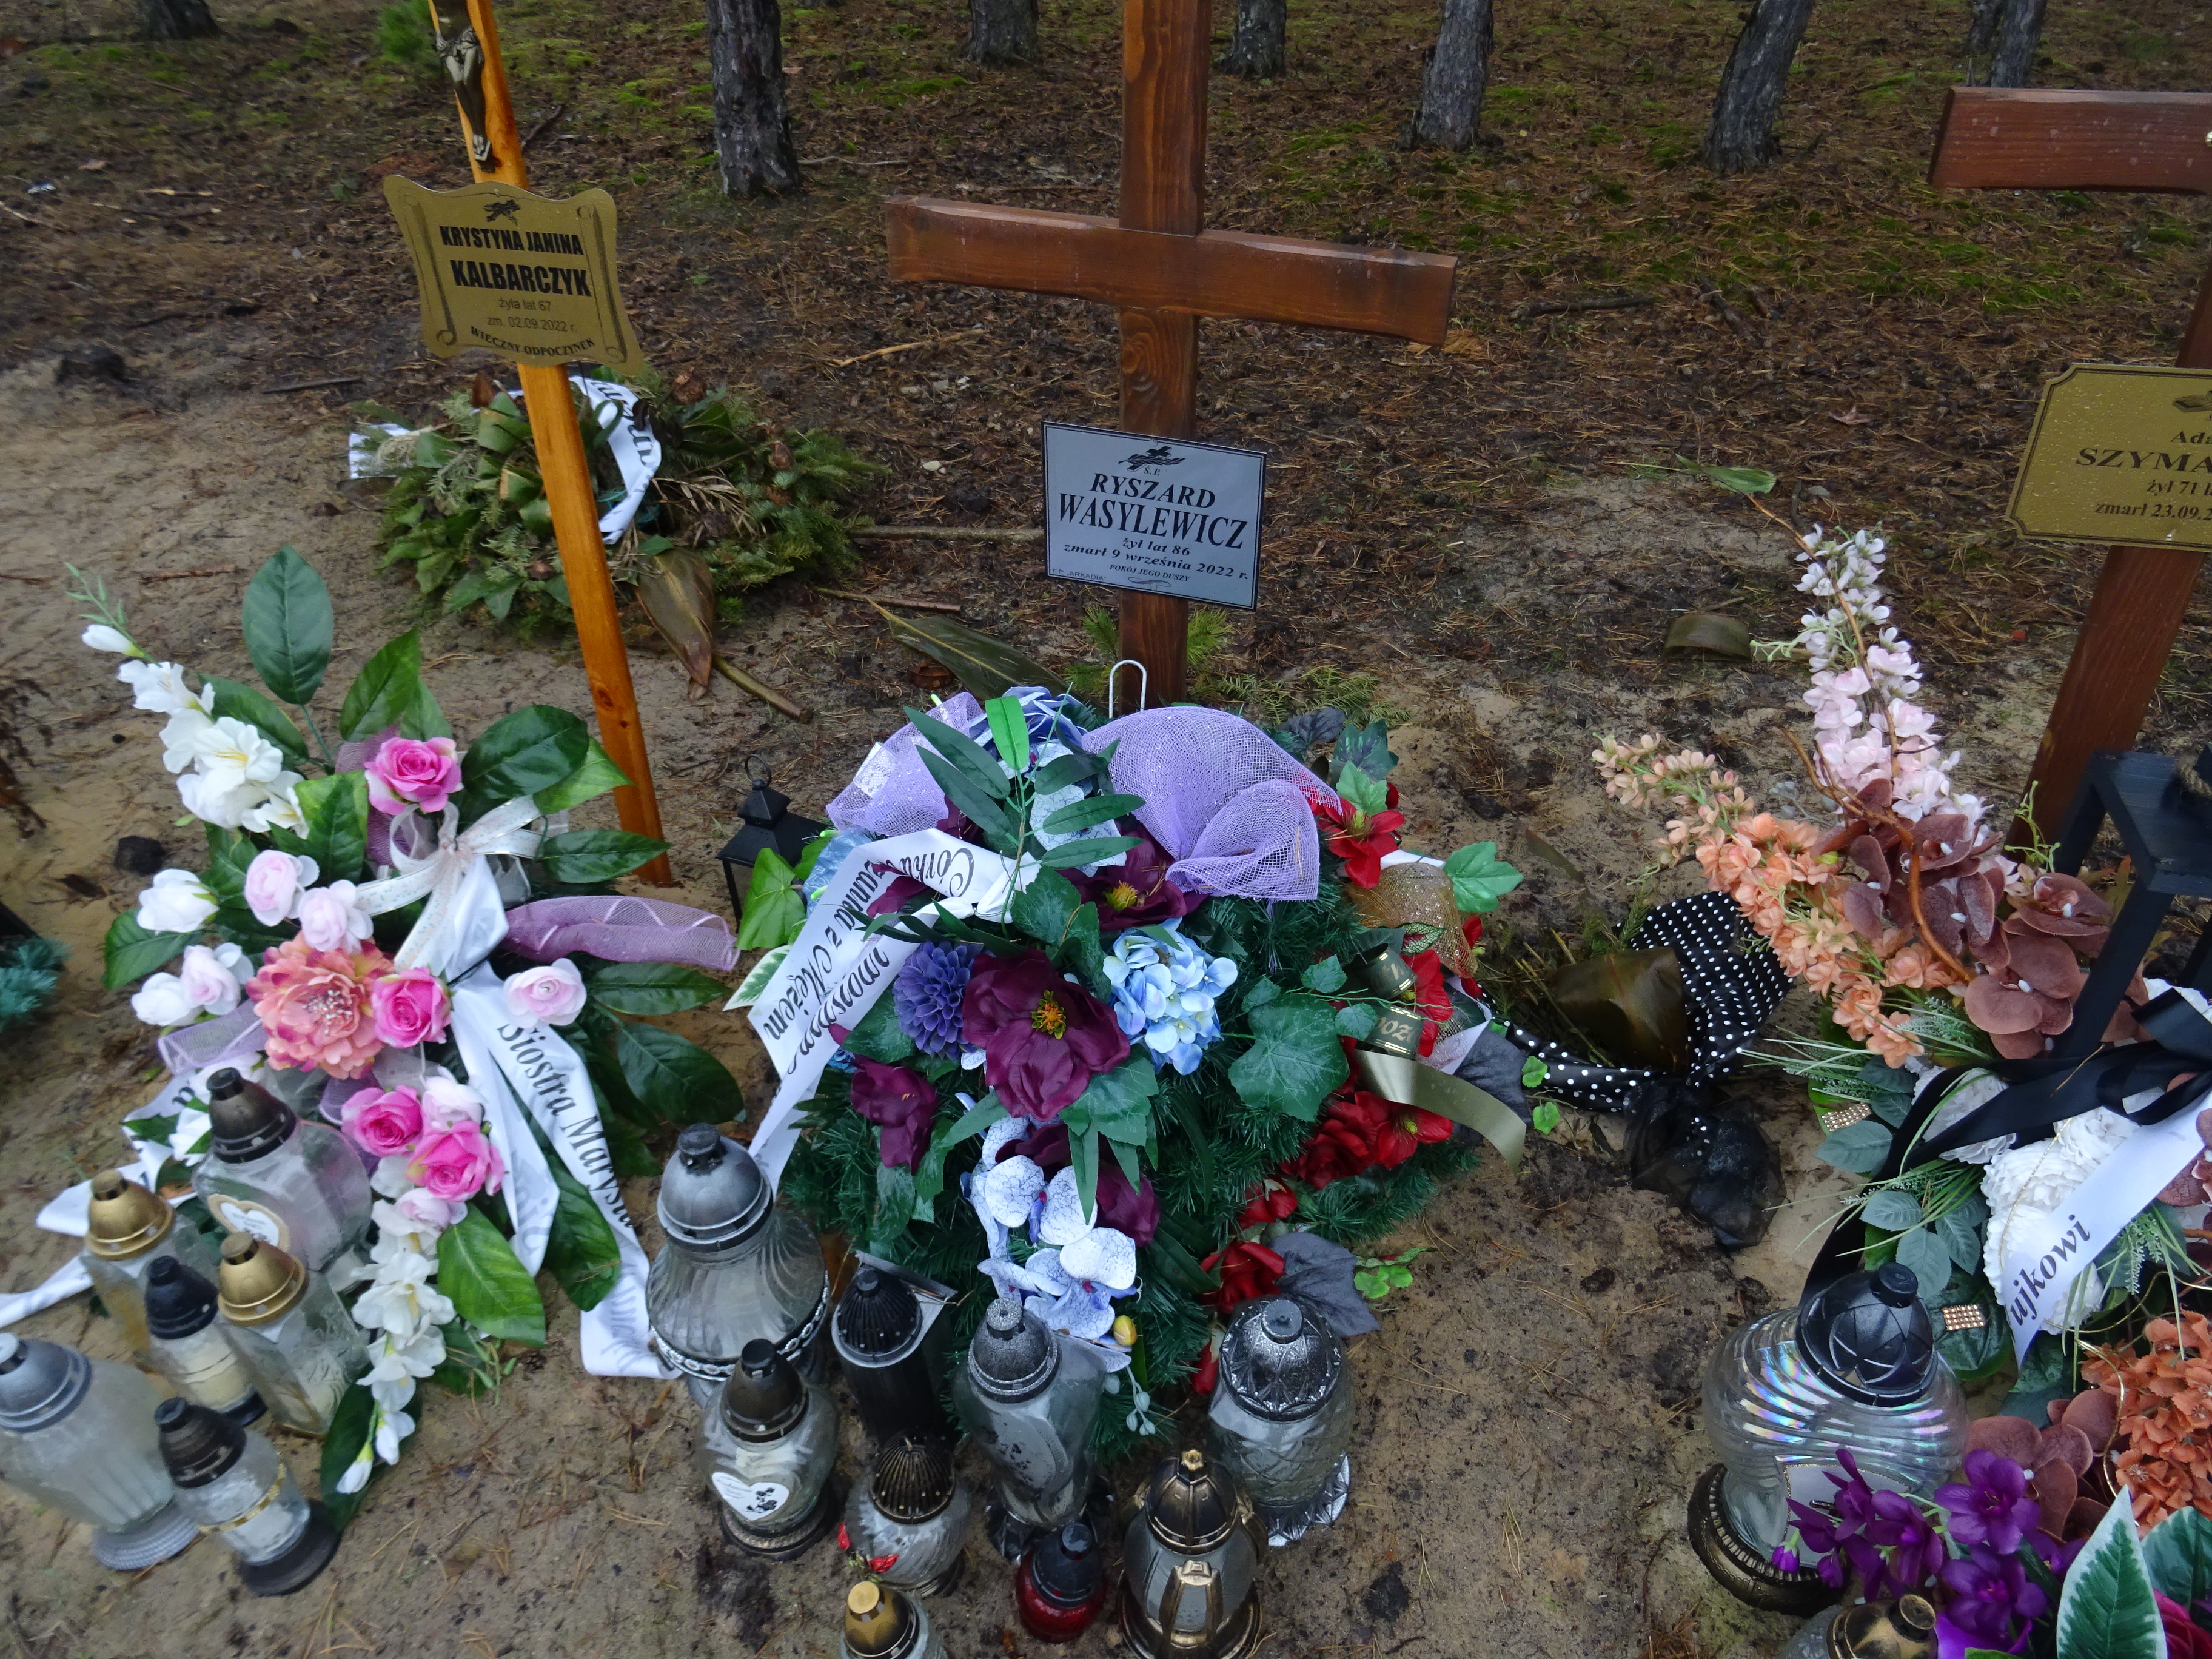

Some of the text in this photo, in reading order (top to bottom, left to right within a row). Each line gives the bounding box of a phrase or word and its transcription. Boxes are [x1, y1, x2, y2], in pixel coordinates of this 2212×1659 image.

[439, 226, 584, 255] KRYSTYNA JANINA
[450, 260, 592, 297] KALBARCZYK
[523, 299, 537, 310] lat
[539, 300, 551, 312] 67
[508, 317, 567, 332] 02.09.2022
[471, 326, 595, 357] WIECZNY ODPOCZYNEK
[1089, 473, 1216, 508] RYSZARD
[2179, 481, 2198, 495] 71
[1059, 493, 1248, 549] WASYLEWICZ
[1122, 537, 1190, 556] żył lat 86
[1064, 544, 1248, 580] zmarł 9 września 2022 r.
[1110, 564, 1190, 582] POKÓJ JEGO DUSZY
[900, 847, 974, 897] Córka
[825, 925, 842, 950] z
[763, 944, 833, 1041] Mężem
